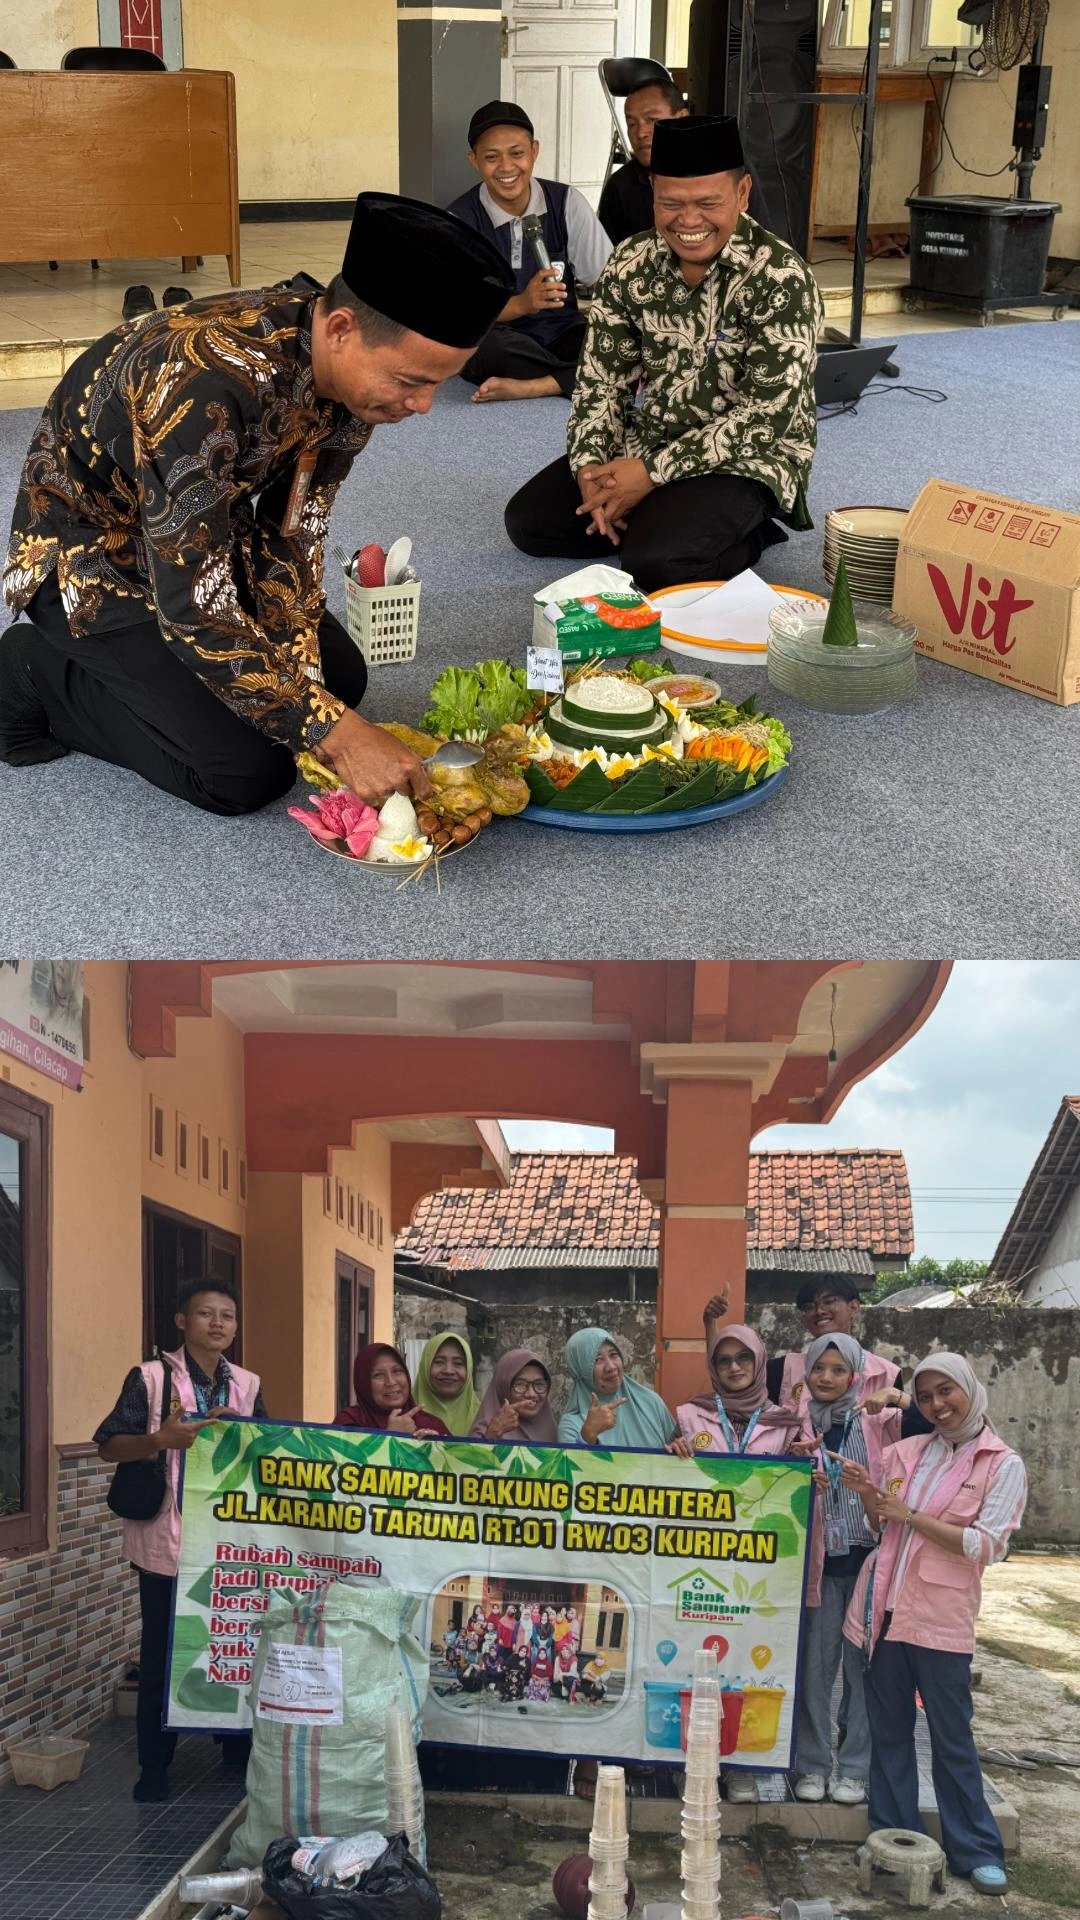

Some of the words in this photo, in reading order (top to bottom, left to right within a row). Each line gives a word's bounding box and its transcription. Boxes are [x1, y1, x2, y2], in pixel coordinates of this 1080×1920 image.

[925, 231, 965, 243] INVENTARIS
[921, 245, 938, 254] DESA
[927, 562, 1035, 656] Vit
[942, 640, 962, 653] Harga
[962, 647, 975, 657] Pas
[975, 651, 1012, 670] Berkualitas
[34, 1046, 68, 1081] Cilacap
[259, 1457, 334, 1491] BANK
[340, 1464, 455, 1502] SAMPAH
[461, 1476, 570, 1510] BAKUNG
[577, 1484, 734, 1521] SEJAHTERA
[216, 1493, 364, 1532] JL.KARANG
[371, 1506, 477, 1542] TARUNA
[484, 1516, 556, 1548] RT.01
[564, 1521, 650, 1552] RW.03
[656, 1527, 776, 1561] KURIPAN
[215, 1542, 290, 1566] Rubah
[296, 1551, 381, 1578] sampah
[212, 1568, 258, 1589] jadi
[263, 1571, 335, 1593] Rupi
[211, 1591, 269, 1612] bersi
[681, 1590, 726, 1603] Bank
[681, 1600, 752, 1615] Sampah
[681, 1610, 734, 1622] Kuripan
[209, 1616, 262, 1636] ber
[207, 1664, 252, 1682] Nab
